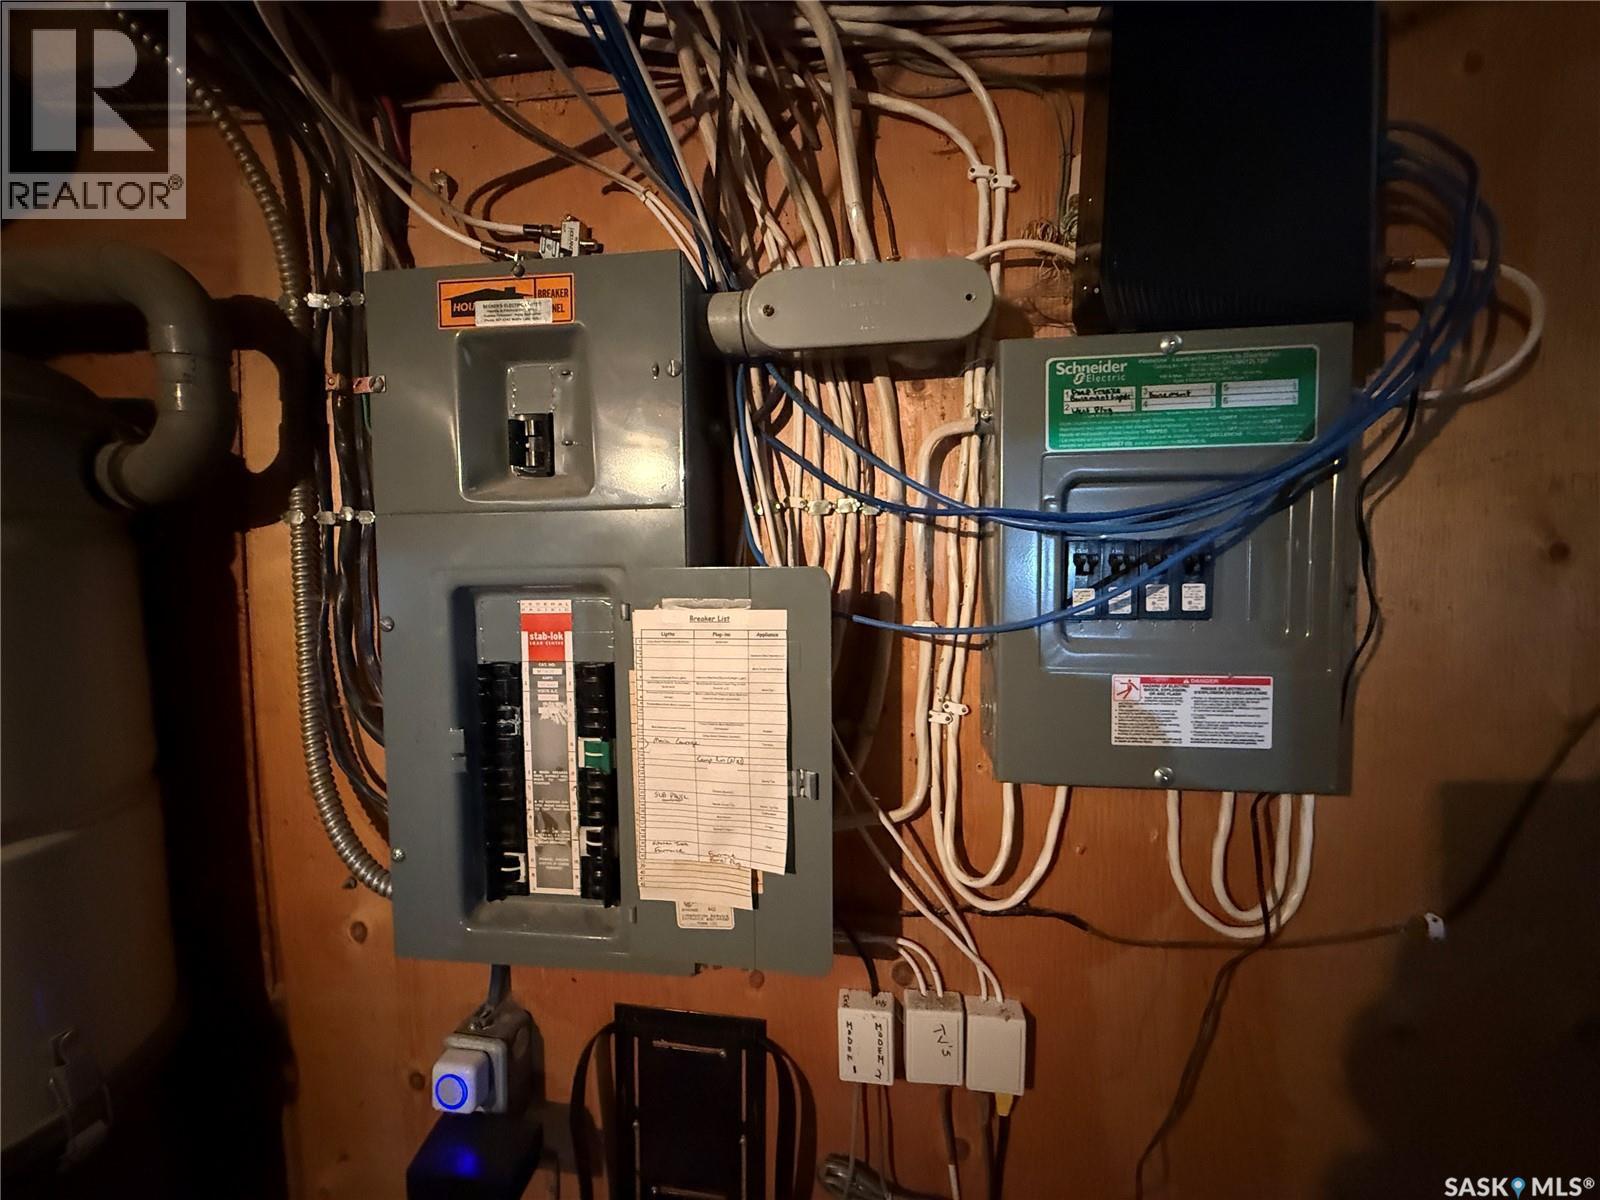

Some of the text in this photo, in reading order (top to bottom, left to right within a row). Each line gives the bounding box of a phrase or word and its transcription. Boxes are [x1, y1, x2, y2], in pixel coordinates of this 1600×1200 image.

[537, 288, 569, 299] BREAKER
[1055, 360, 1128, 376] Schneider
[1086, 374, 1126, 383] Electric
[689, 615, 730, 624] Breaker List
[529, 631, 564, 641] stab-lok
